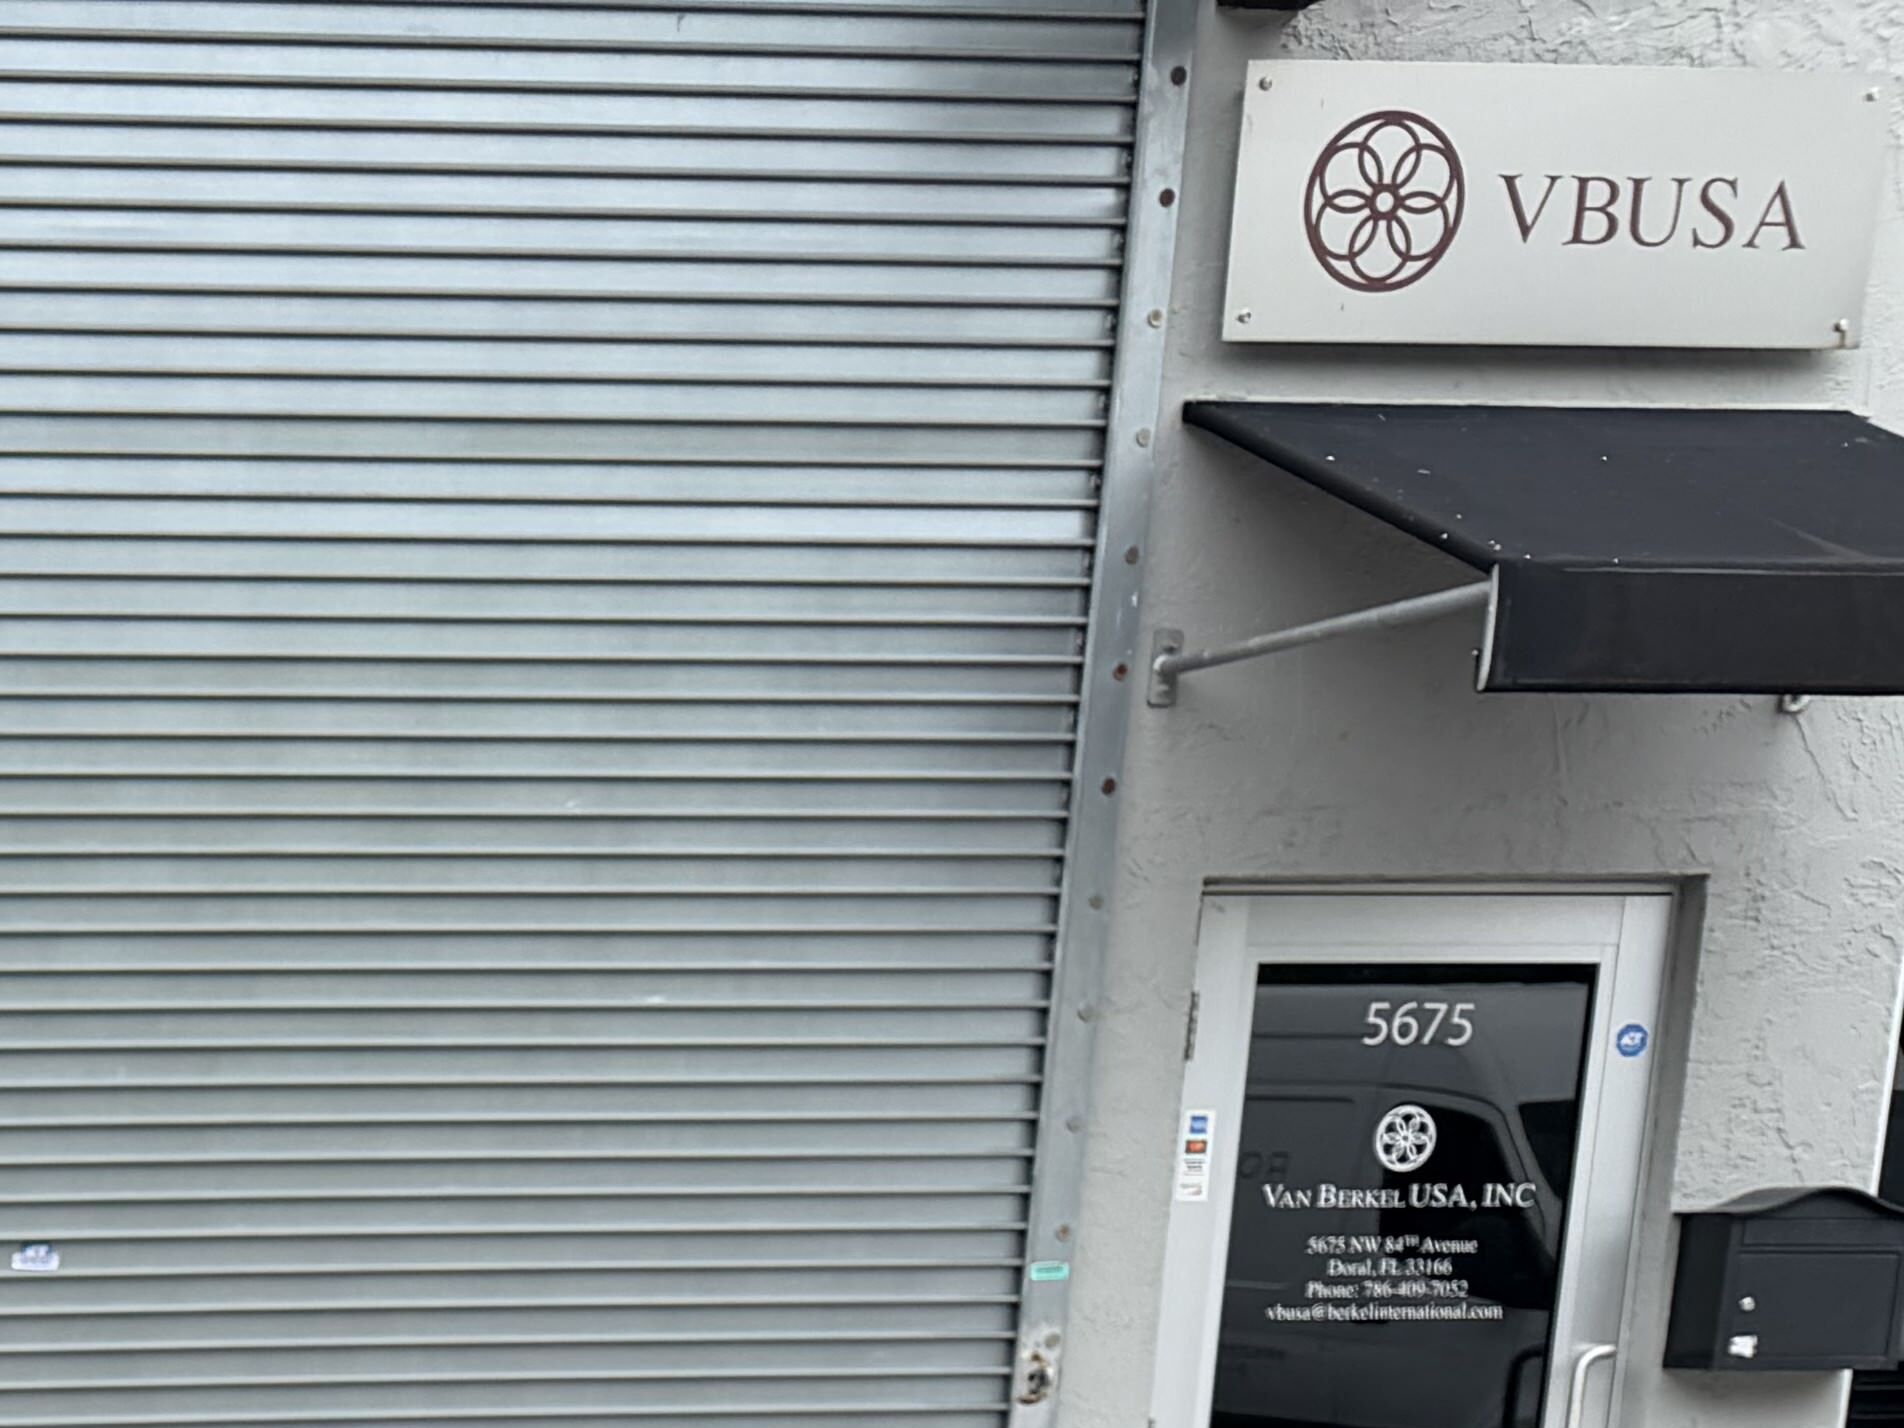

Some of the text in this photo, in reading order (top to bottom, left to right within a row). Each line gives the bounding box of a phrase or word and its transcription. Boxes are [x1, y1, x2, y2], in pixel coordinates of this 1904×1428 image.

[1497, 172, 1807, 251] VBUSA
[1361, 1001, 1476, 1047] 5675
[1408, 1183, 1477, 1211] USA,
[1481, 1183, 1537, 1208] INC
[1305, 1236, 1346, 1254] 5675
[1348, 1236, 1381, 1254] NW
[1419, 1237, 1478, 1254] Avenue
[1378, 1258, 1402, 1275] FL
[1405, 1258, 1453, 1276] 33166
[1304, 1280, 1359, 1298] Phone:
